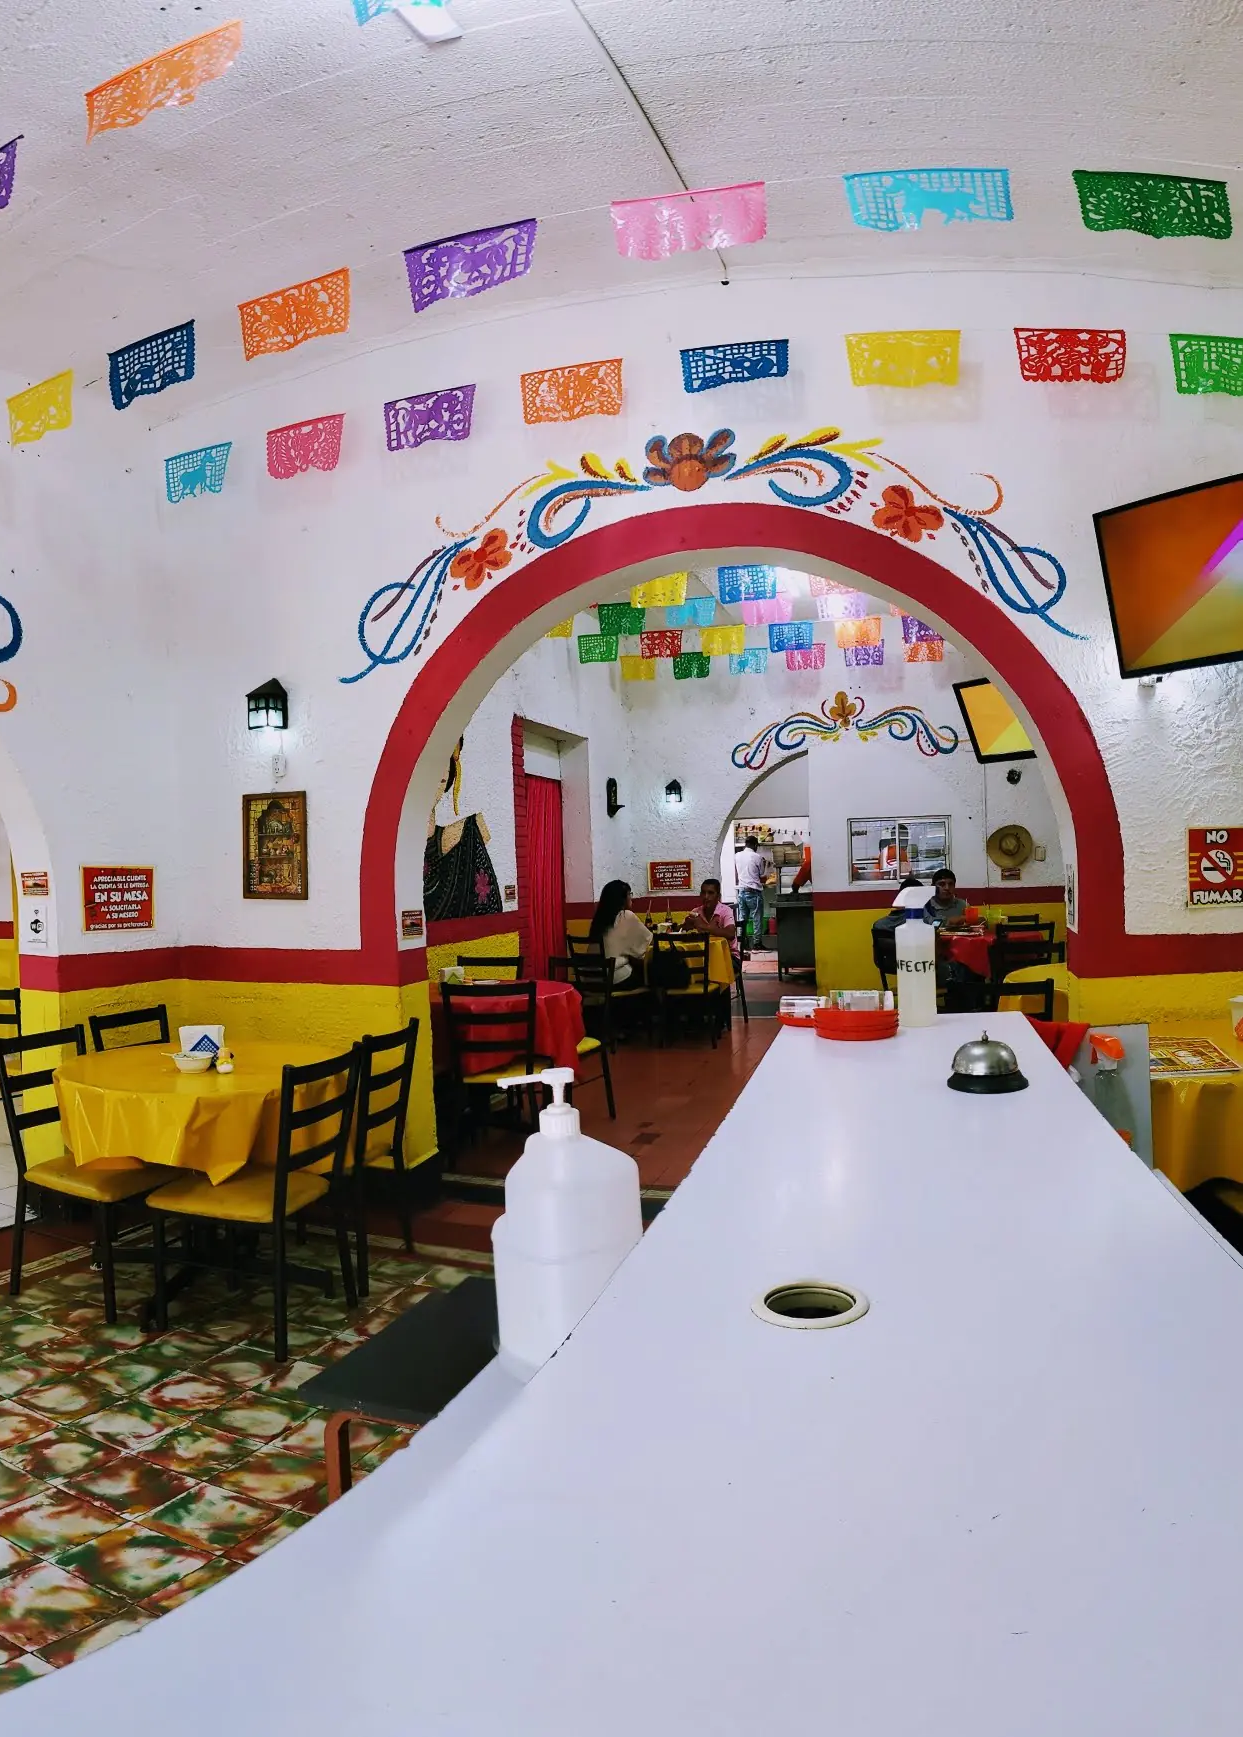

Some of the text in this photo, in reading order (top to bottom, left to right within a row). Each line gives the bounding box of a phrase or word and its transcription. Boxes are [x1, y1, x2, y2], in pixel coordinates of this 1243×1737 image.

[1206, 830, 1228, 844] NO
[94, 890, 148, 902] EN SU MESA
[1192, 888, 1243, 905] FUMAR
